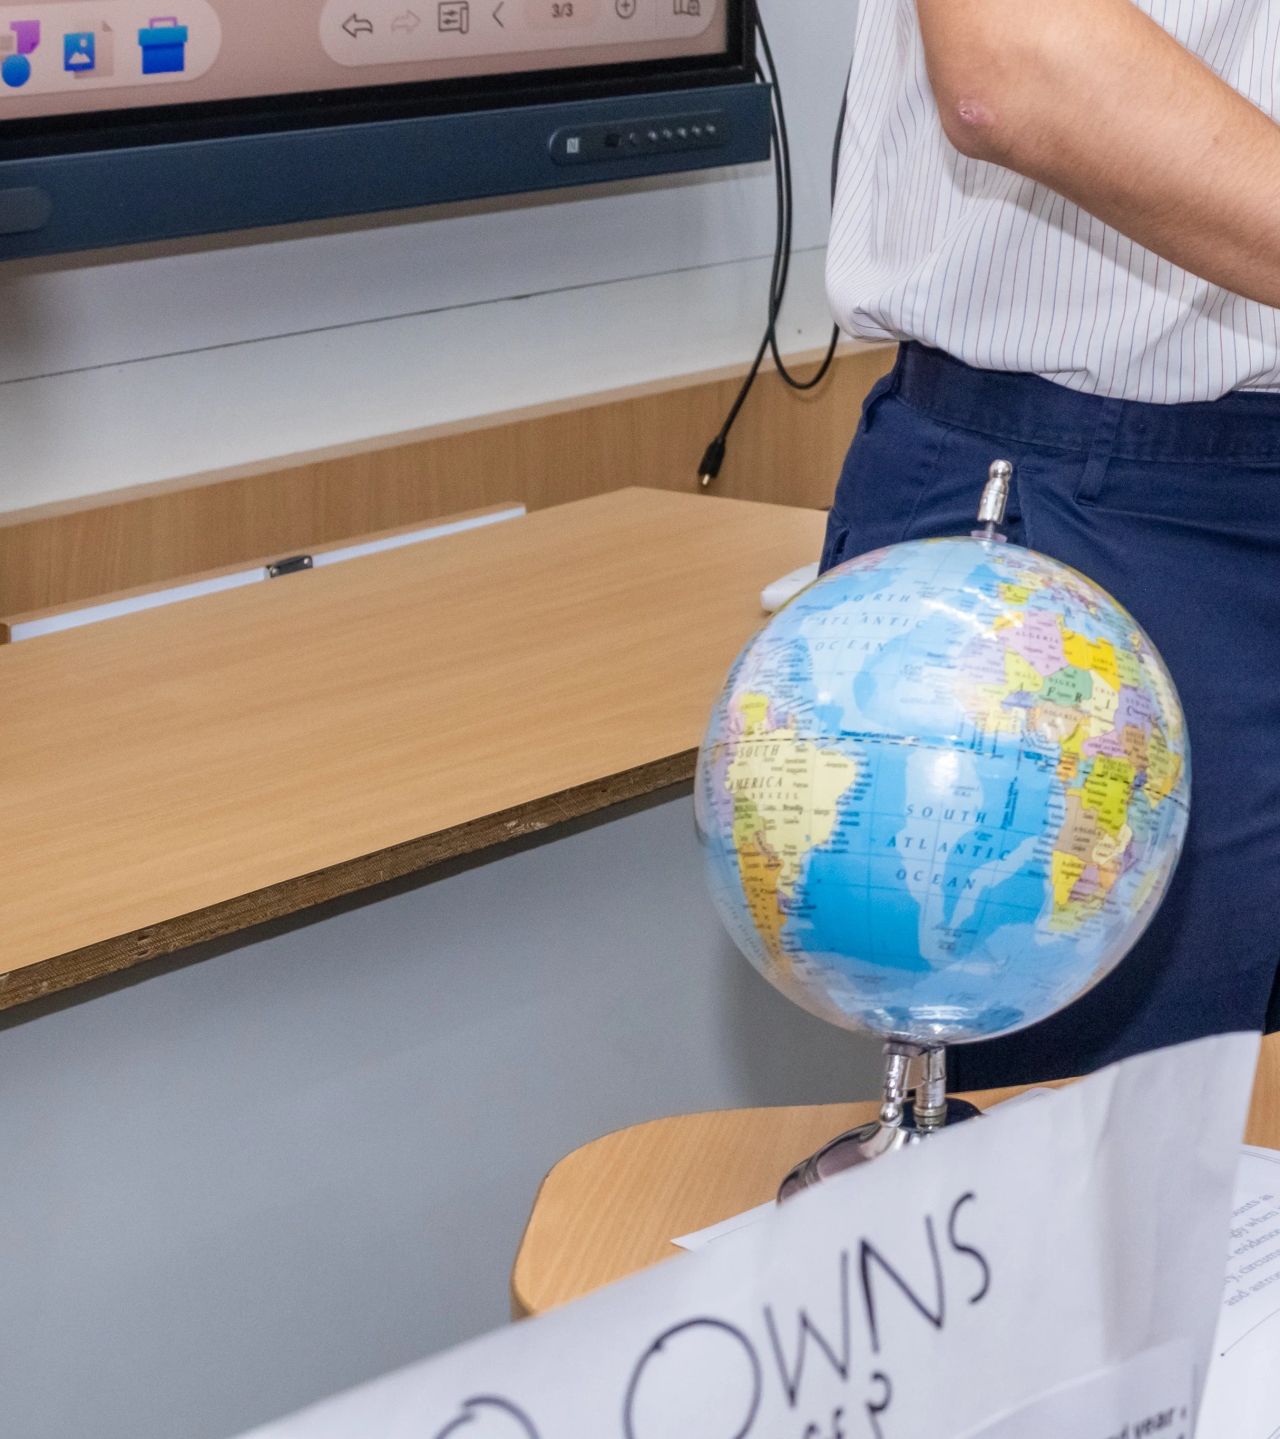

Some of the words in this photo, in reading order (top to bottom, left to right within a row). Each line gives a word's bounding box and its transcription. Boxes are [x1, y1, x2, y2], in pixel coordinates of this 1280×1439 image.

[550, 2, 574, 20] 3/3
[818, 615, 925, 629] ATLANTIC
[814, 639, 885, 652] OCEAN
[729, 776, 783, 790] AMERICA
[906, 804, 987, 823] SOUTH
[887, 836, 1011, 861] ATLANTIC
[896, 869, 976, 889] OCEAN
[1244, 1210, 1280, 1228] when
[1224, 1289, 1251, 1307] and
[623, 1190, 992, 1439] OWNS
